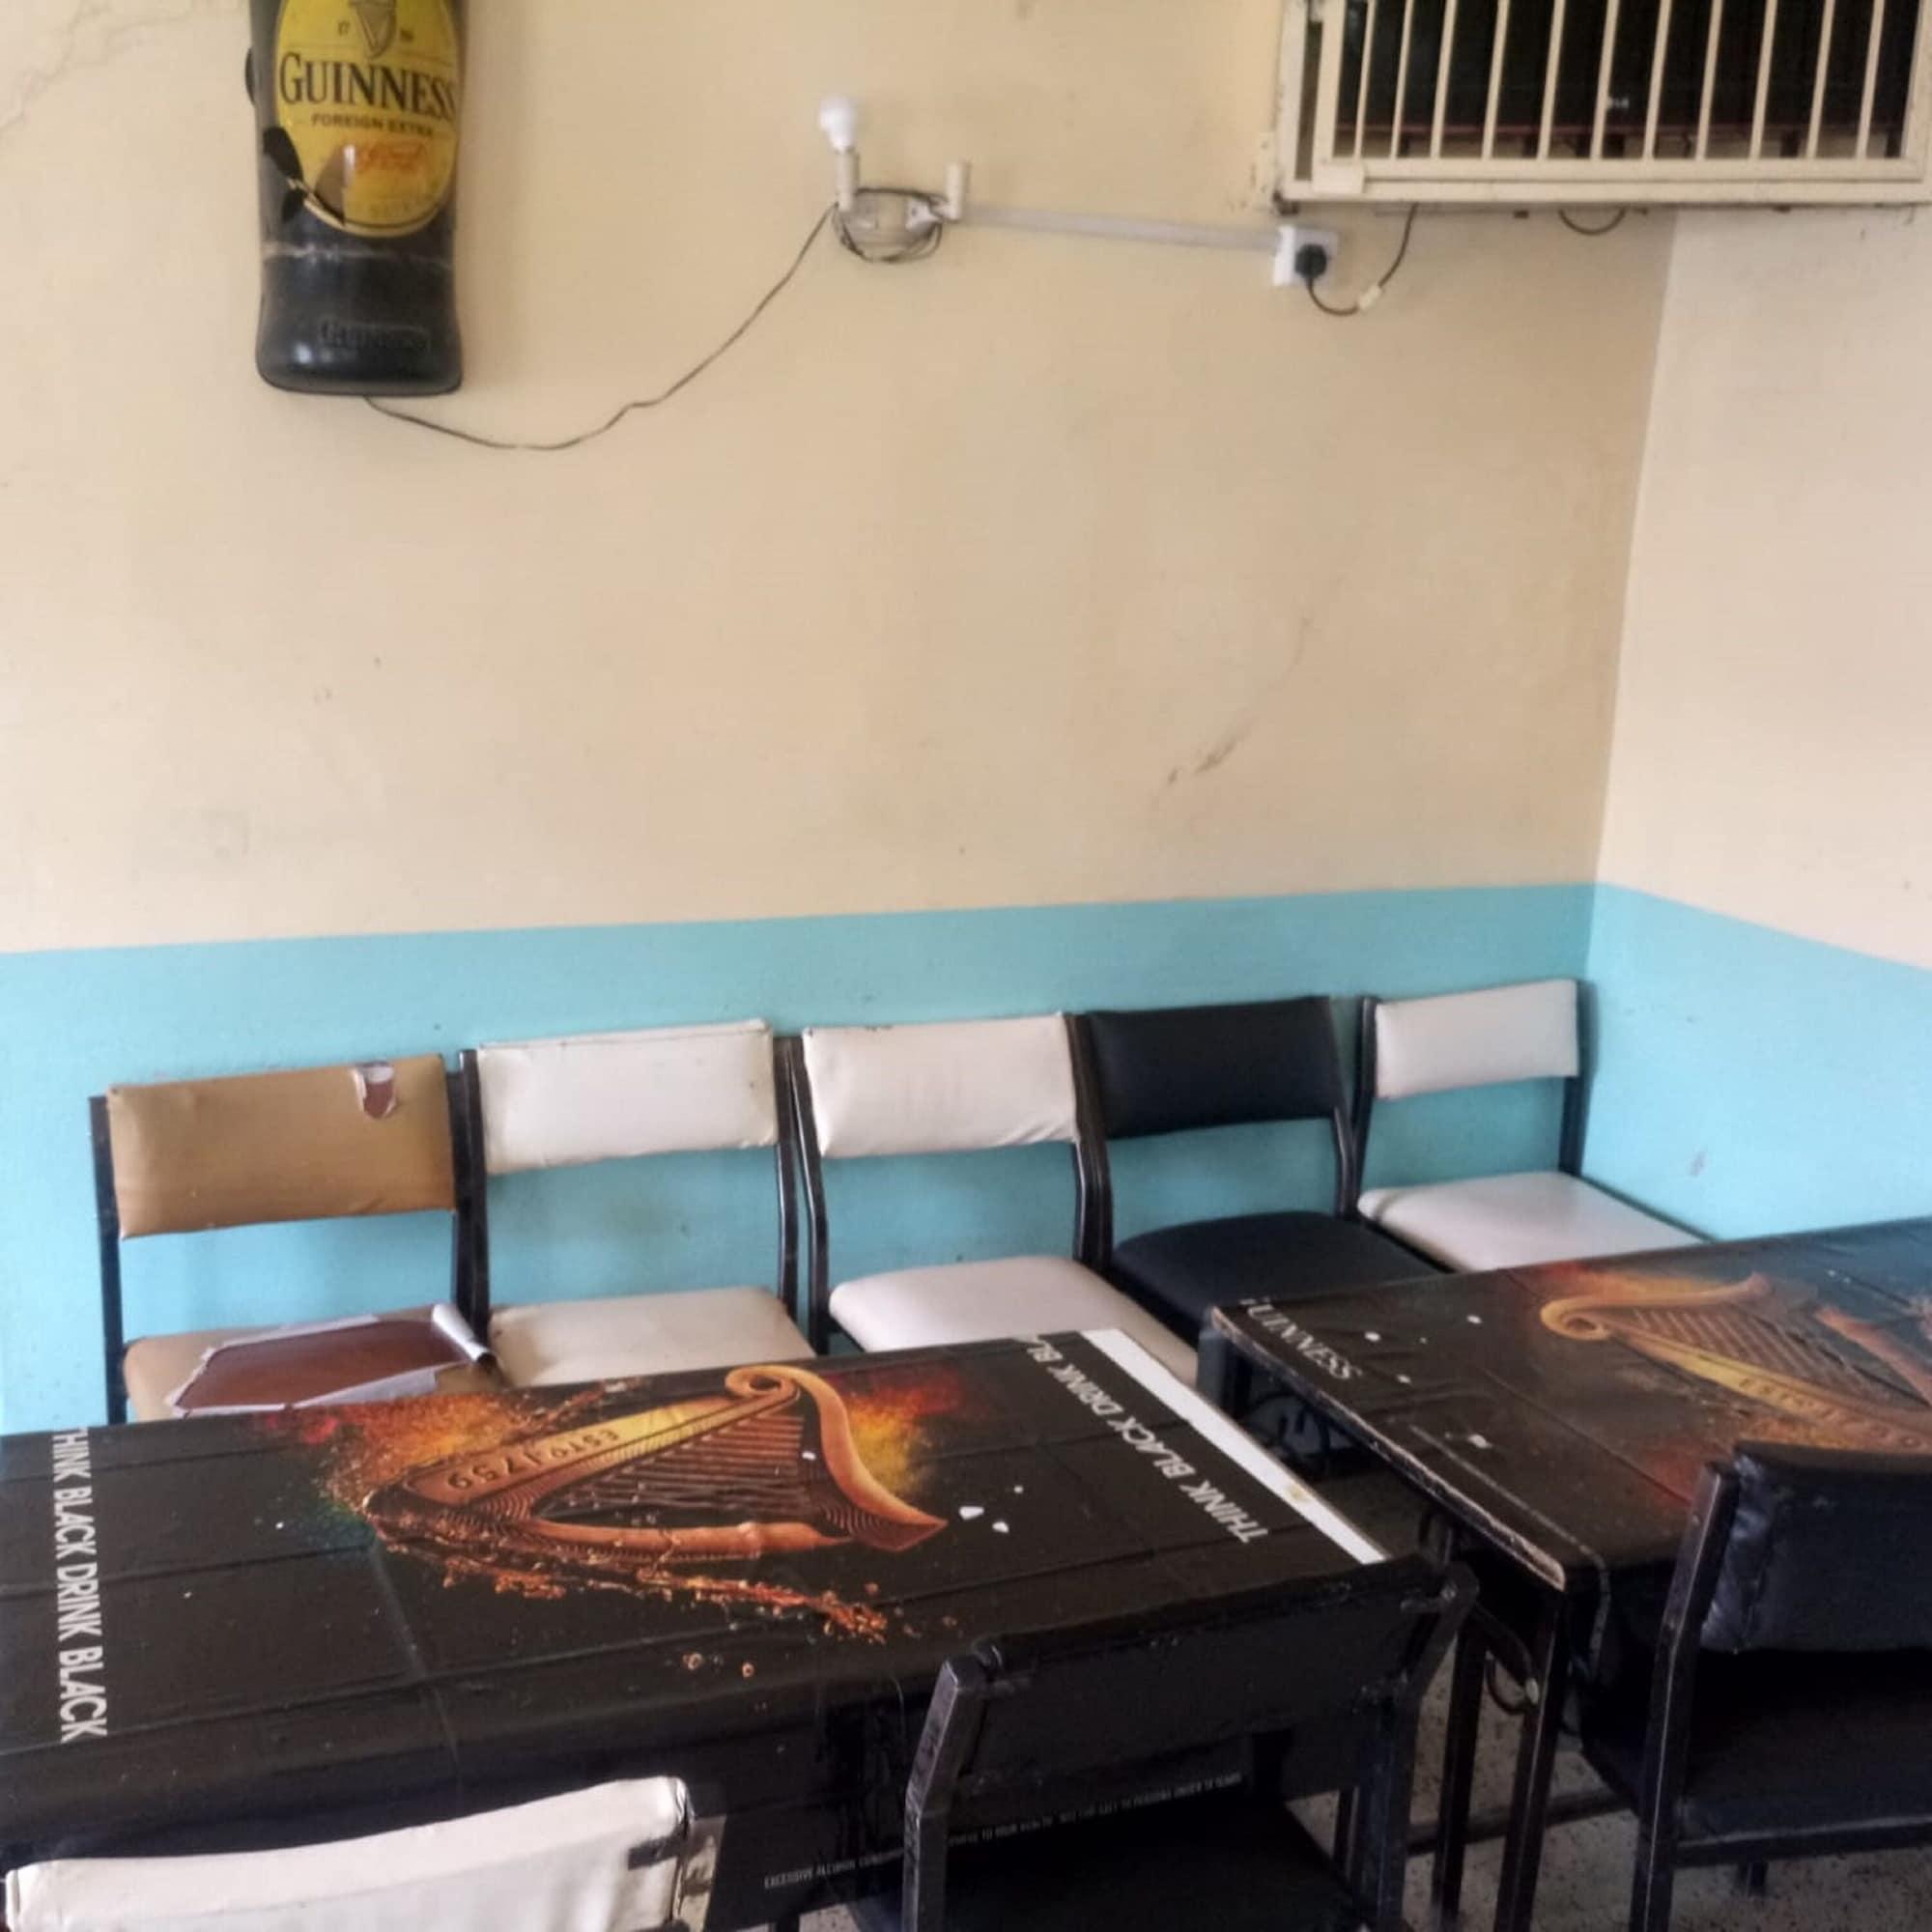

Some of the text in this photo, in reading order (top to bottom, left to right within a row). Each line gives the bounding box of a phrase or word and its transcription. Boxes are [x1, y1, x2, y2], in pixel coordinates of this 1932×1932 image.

[279, 52, 458, 122] GUINNESS
[311, 113, 383, 129] FOREIGN
[1047, 1364, 1124, 1416] DRINK
[1107, 1416, 1197, 1479] BLACK
[53, 1486, 97, 1560] BLACK
[1179, 1481, 1268, 1544] THINK
[56, 1562, 102, 1641] DRINK
[58, 1645, 108, 1744] BLACK
